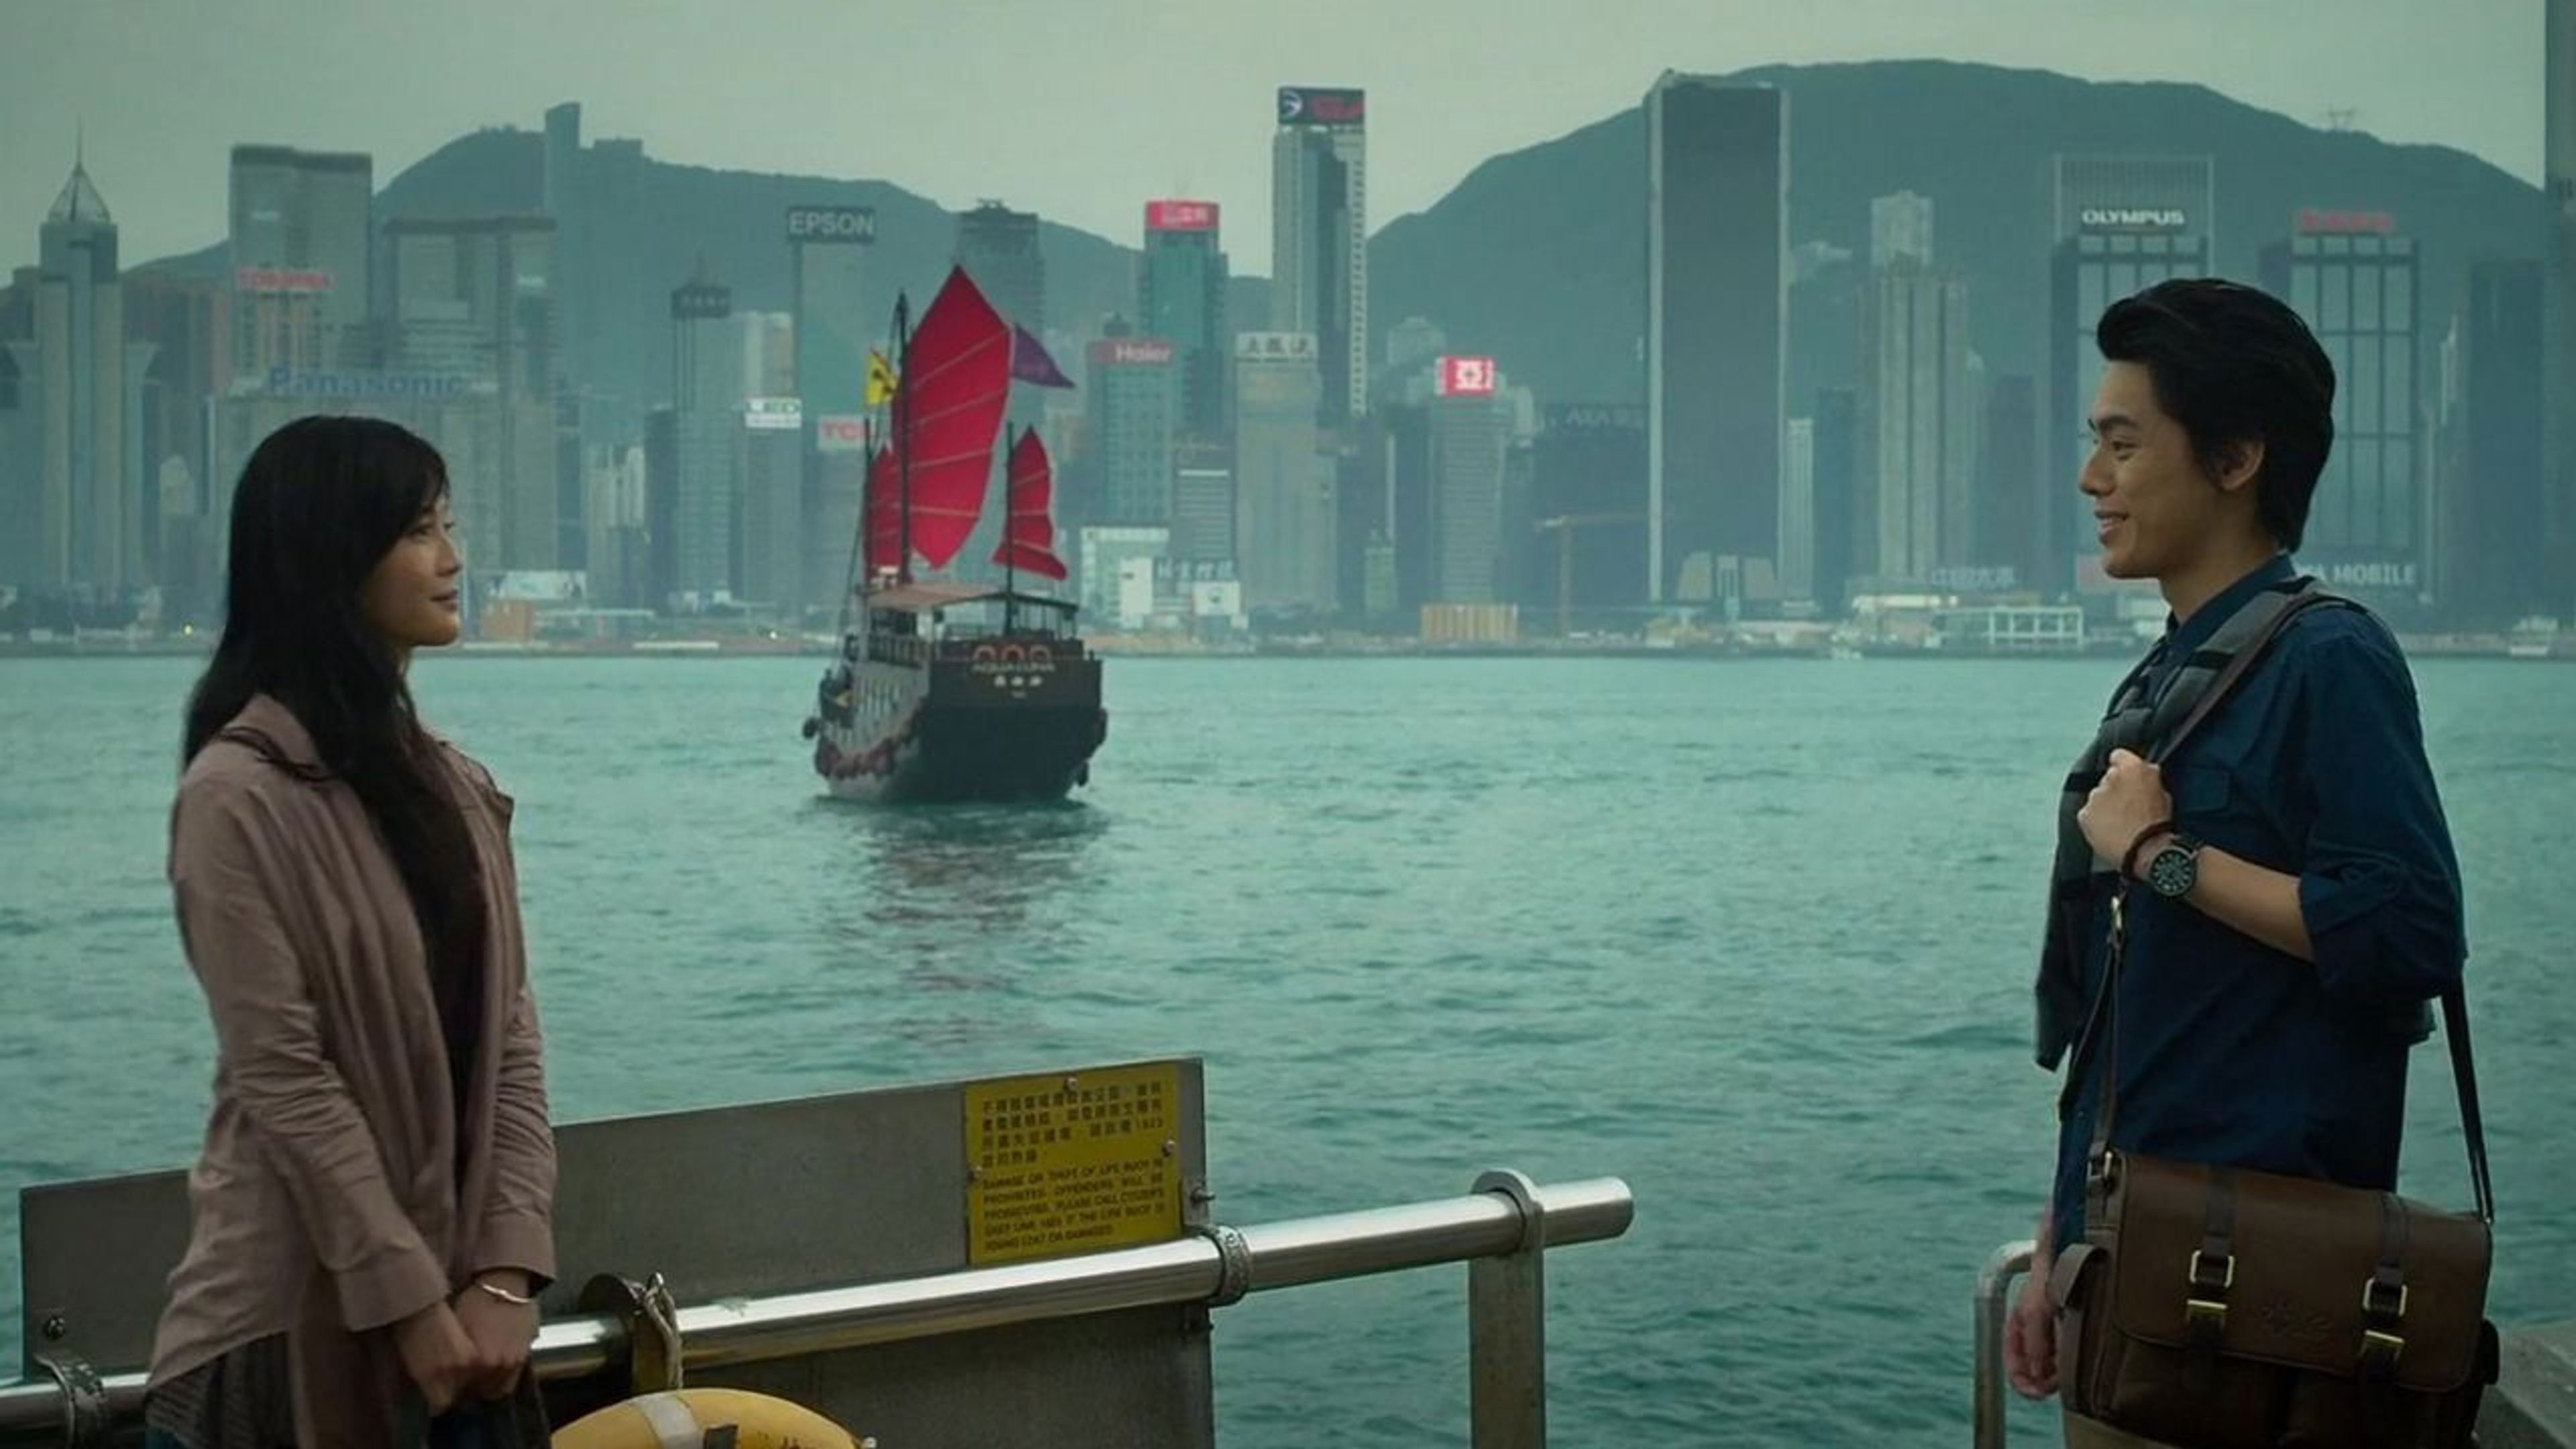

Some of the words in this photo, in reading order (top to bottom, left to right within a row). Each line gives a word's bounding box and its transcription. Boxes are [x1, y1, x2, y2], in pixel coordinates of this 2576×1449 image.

[789, 211, 873, 235] EPSON
[2082, 210, 2185, 225] OLYMPUS
[1116, 343, 1171, 362] Haier
[270, 366, 464, 396] Panasonic
[2333, 564, 2416, 586] MOBILE
